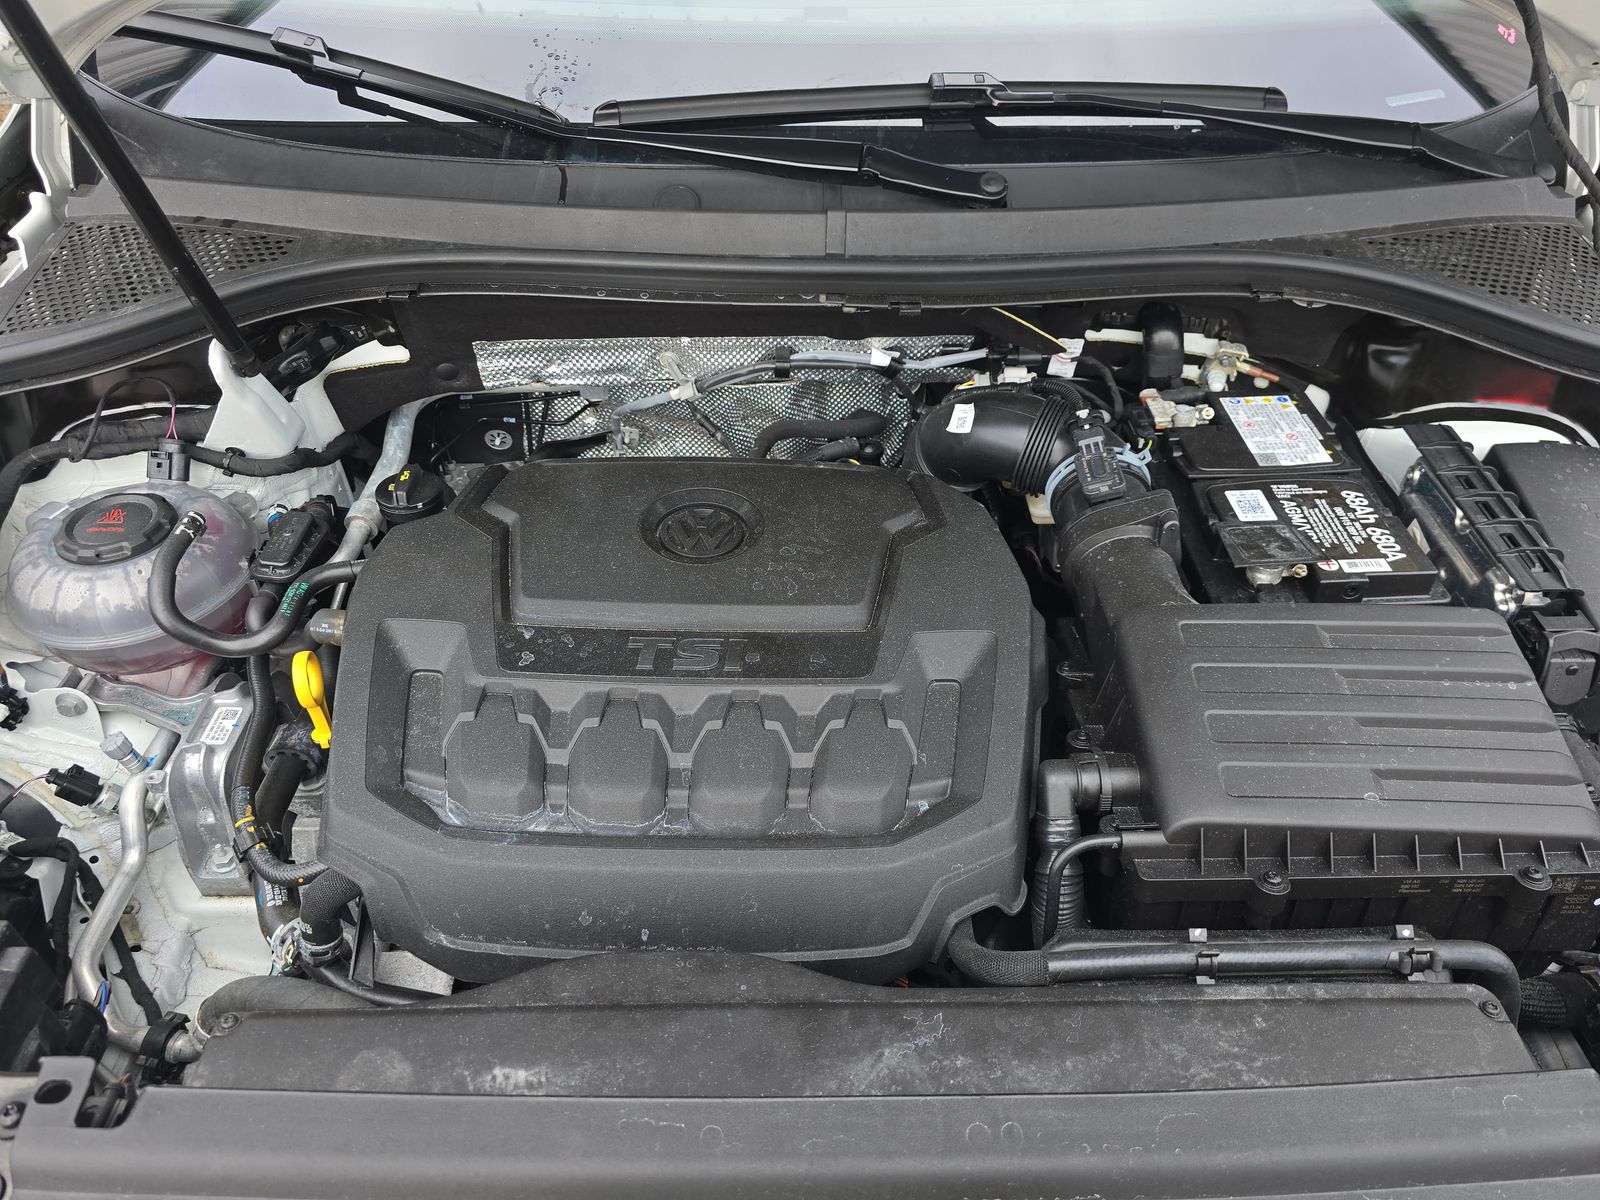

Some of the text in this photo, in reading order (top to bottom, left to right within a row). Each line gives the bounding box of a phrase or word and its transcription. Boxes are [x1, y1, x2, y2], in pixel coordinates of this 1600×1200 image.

[1341, 490, 1407, 562] 68Ah 680A
[628, 637, 748, 671] TSI
